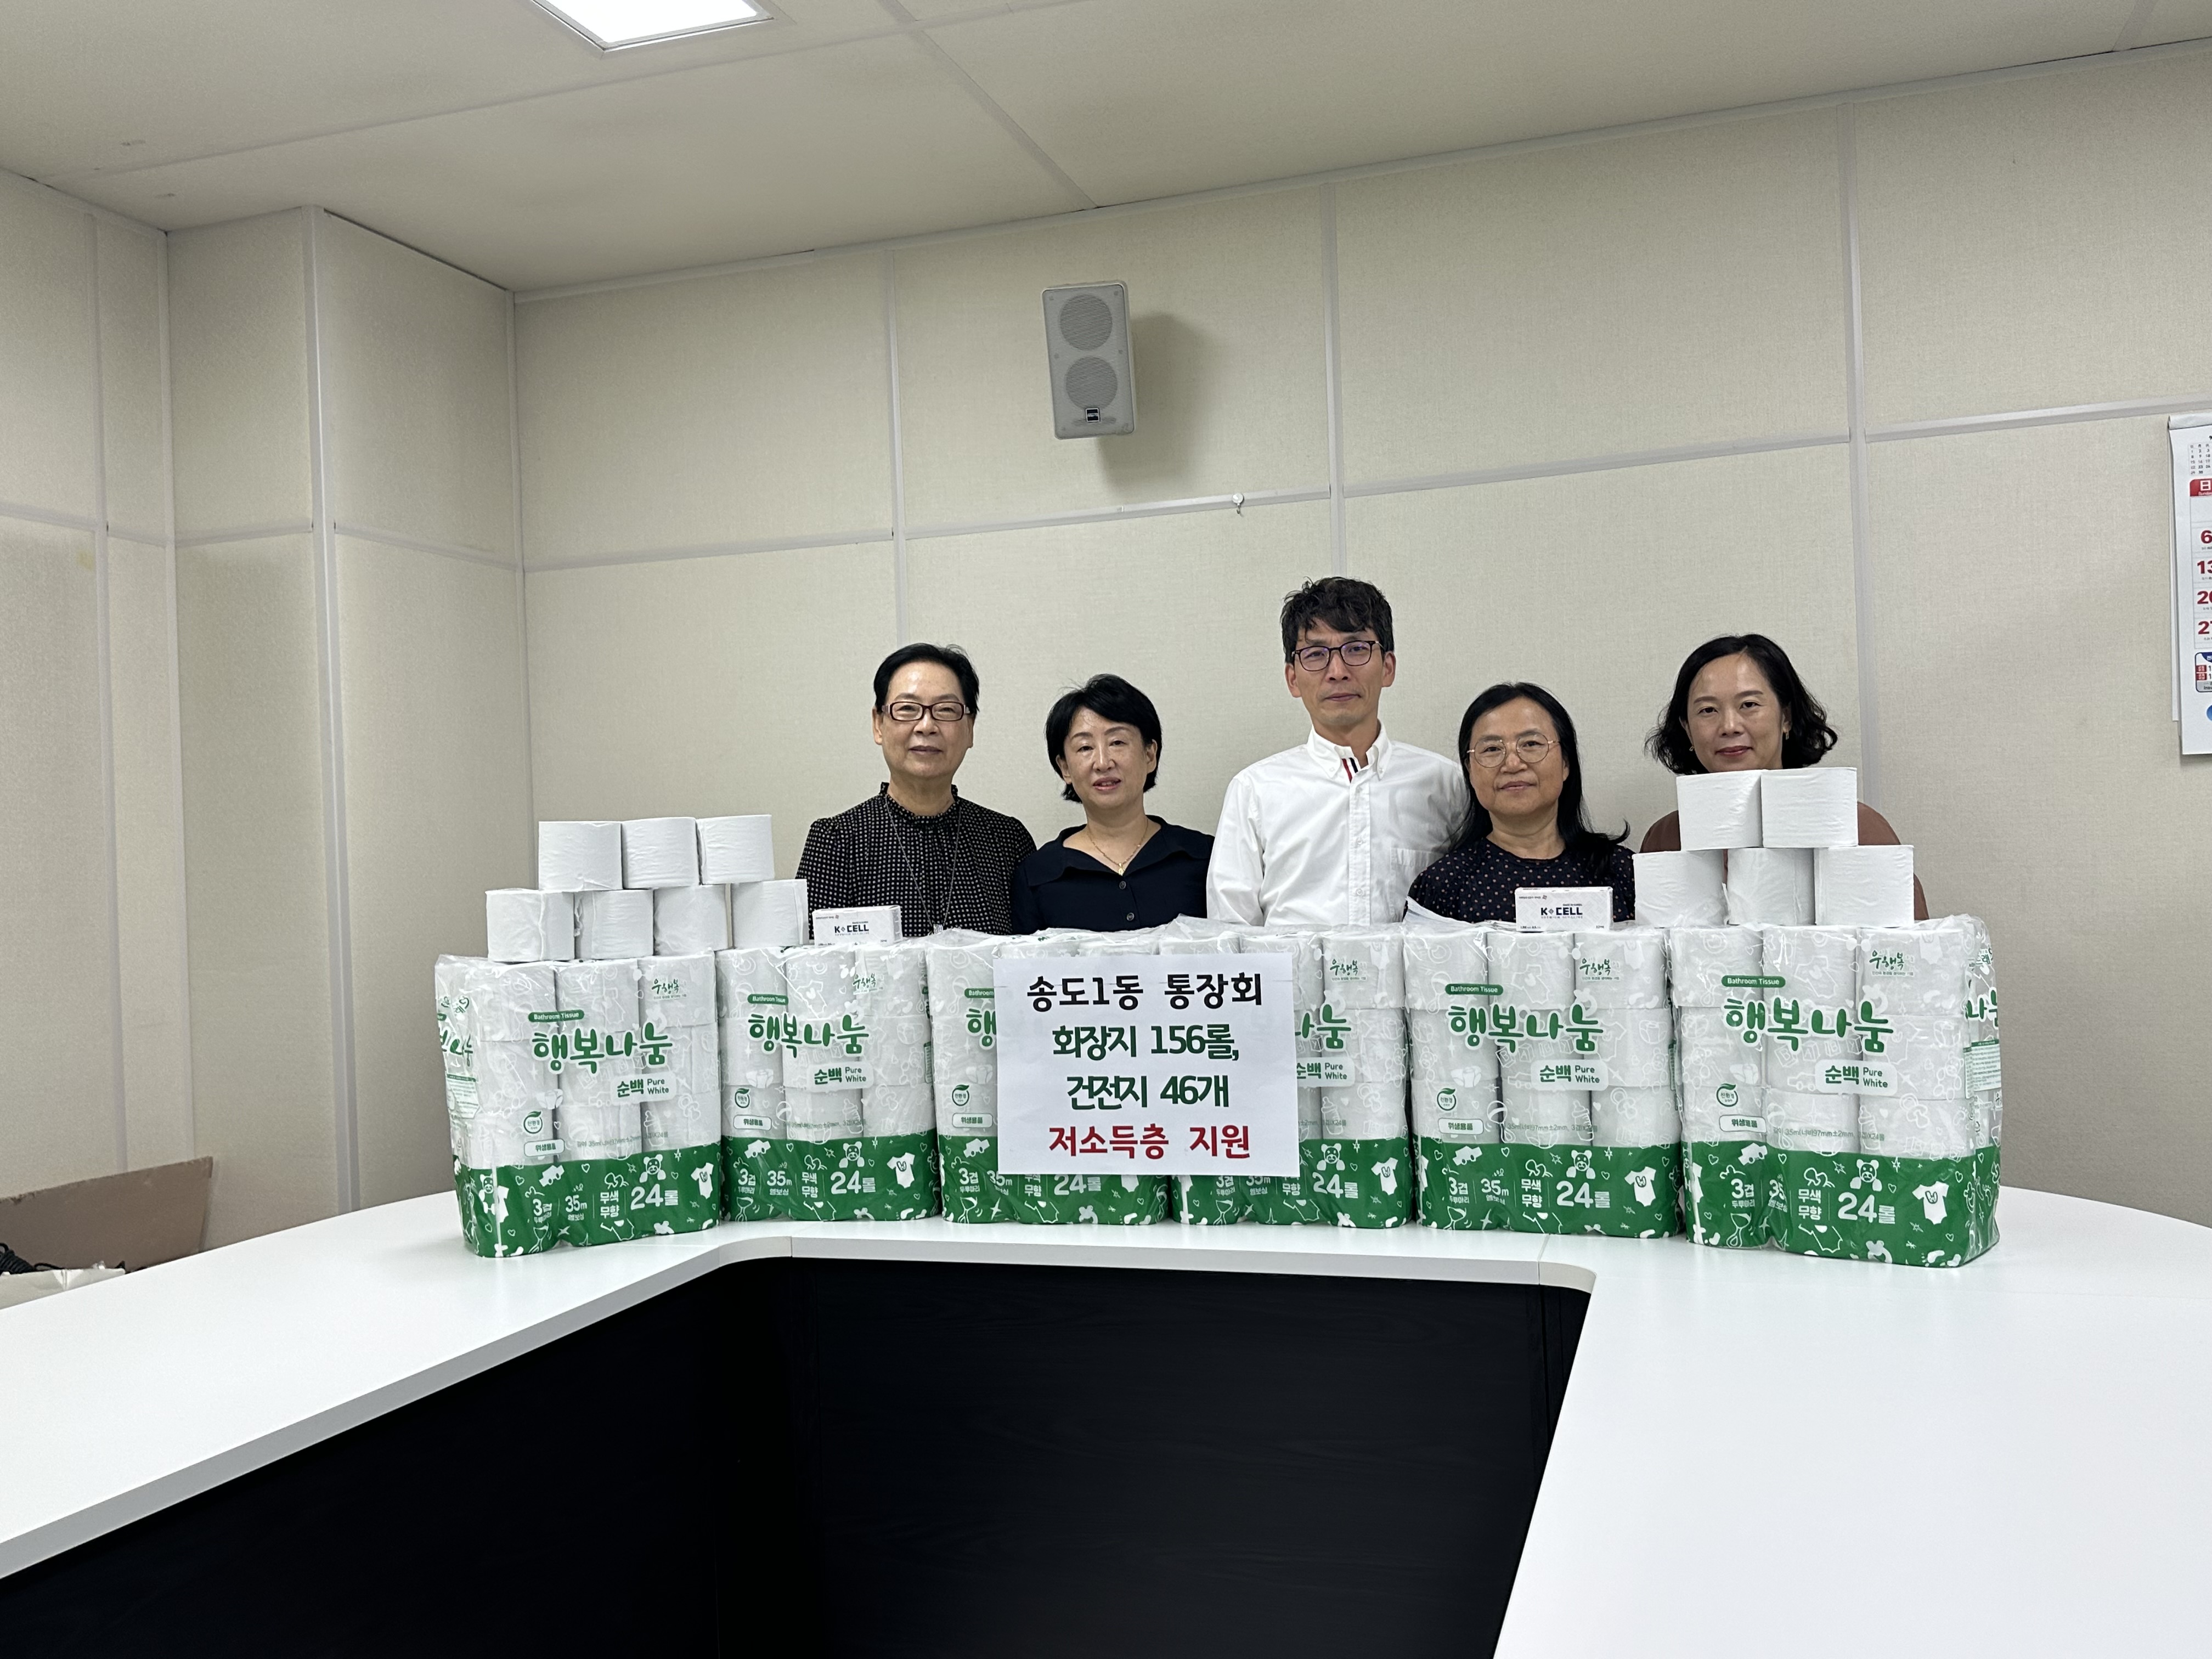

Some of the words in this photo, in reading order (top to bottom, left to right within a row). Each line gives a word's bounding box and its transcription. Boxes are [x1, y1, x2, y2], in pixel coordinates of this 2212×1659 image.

[2200, 480, 2211, 491] 日
[2200, 530, 2212, 544] 6
[2198, 621, 2212, 634] 2
[1026, 975, 1144, 1012] 송도1동
[1164, 972, 1262, 1009] 통장회
[533, 1011, 560, 1019] Bathroom
[561, 1011, 579, 1019] Tissue
[1448, 1004, 1604, 1053] 행복나눔
[1724, 997, 1894, 1053] 행복나눔
[748, 1013, 869, 1058] 행복나눔
[1052, 1025, 1137, 1061] 화장지
[1150, 1024, 1239, 1061] 156롤,
[532, 1022, 673, 1074] 행복나눔
[1325, 1062, 1344, 1070] Pure
[1539, 1065, 1572, 1082] 순백
[1575, 1065, 1595, 1074] Pure
[1863, 1066, 1883, 1077] Pure
[814, 1067, 842, 1085] 순백
[1575, 1075, 1600, 1084] White
[1825, 1065, 1859, 1085] 순백
[1863, 1078, 1888, 1088] White
[617, 1079, 644, 1097] 순백
[647, 1086, 669, 1094] White
[1066, 1075, 1148, 1110] 건전지
[1160, 1075, 1229, 1108] 46개
[1049, 1124, 1169, 1160] 저소득층
[1189, 1125, 1250, 1160] 지원
[738, 1169, 756, 1186] 3겹
[767, 1170, 792, 1186] 35m
[802, 1172, 817, 1184] 무색
[831, 1170, 876, 1194] 24롤
[959, 1167, 979, 1185] 3겹
[802, 1186, 819, 1198] 무향
[1025, 1185, 1041, 1197] 무향
[1053, 1174, 1102, 1196] 24롤
[1283, 1183, 1300, 1196] 무향
[1312, 1172, 1358, 1198] 24롤
[1448, 1177, 1469, 1195] 3겹
[1480, 1178, 1509, 1196] 35m
[1521, 1178, 1542, 1193] 무색
[1730, 1178, 1754, 1198] 3겹
[600, 1190, 619, 1203] 무색
[630, 1183, 679, 1210] 24롤
[1522, 1195, 1542, 1208] 무향
[1556, 1181, 1611, 1208] 24롤
[1798, 1189, 1821, 1204] 무색
[565, 1195, 587, 1212] 35m
[600, 1206, 619, 1218] 무향
[1838, 1192, 1895, 1224] 24롤
[1798, 1205, 1821, 1220] 무향
